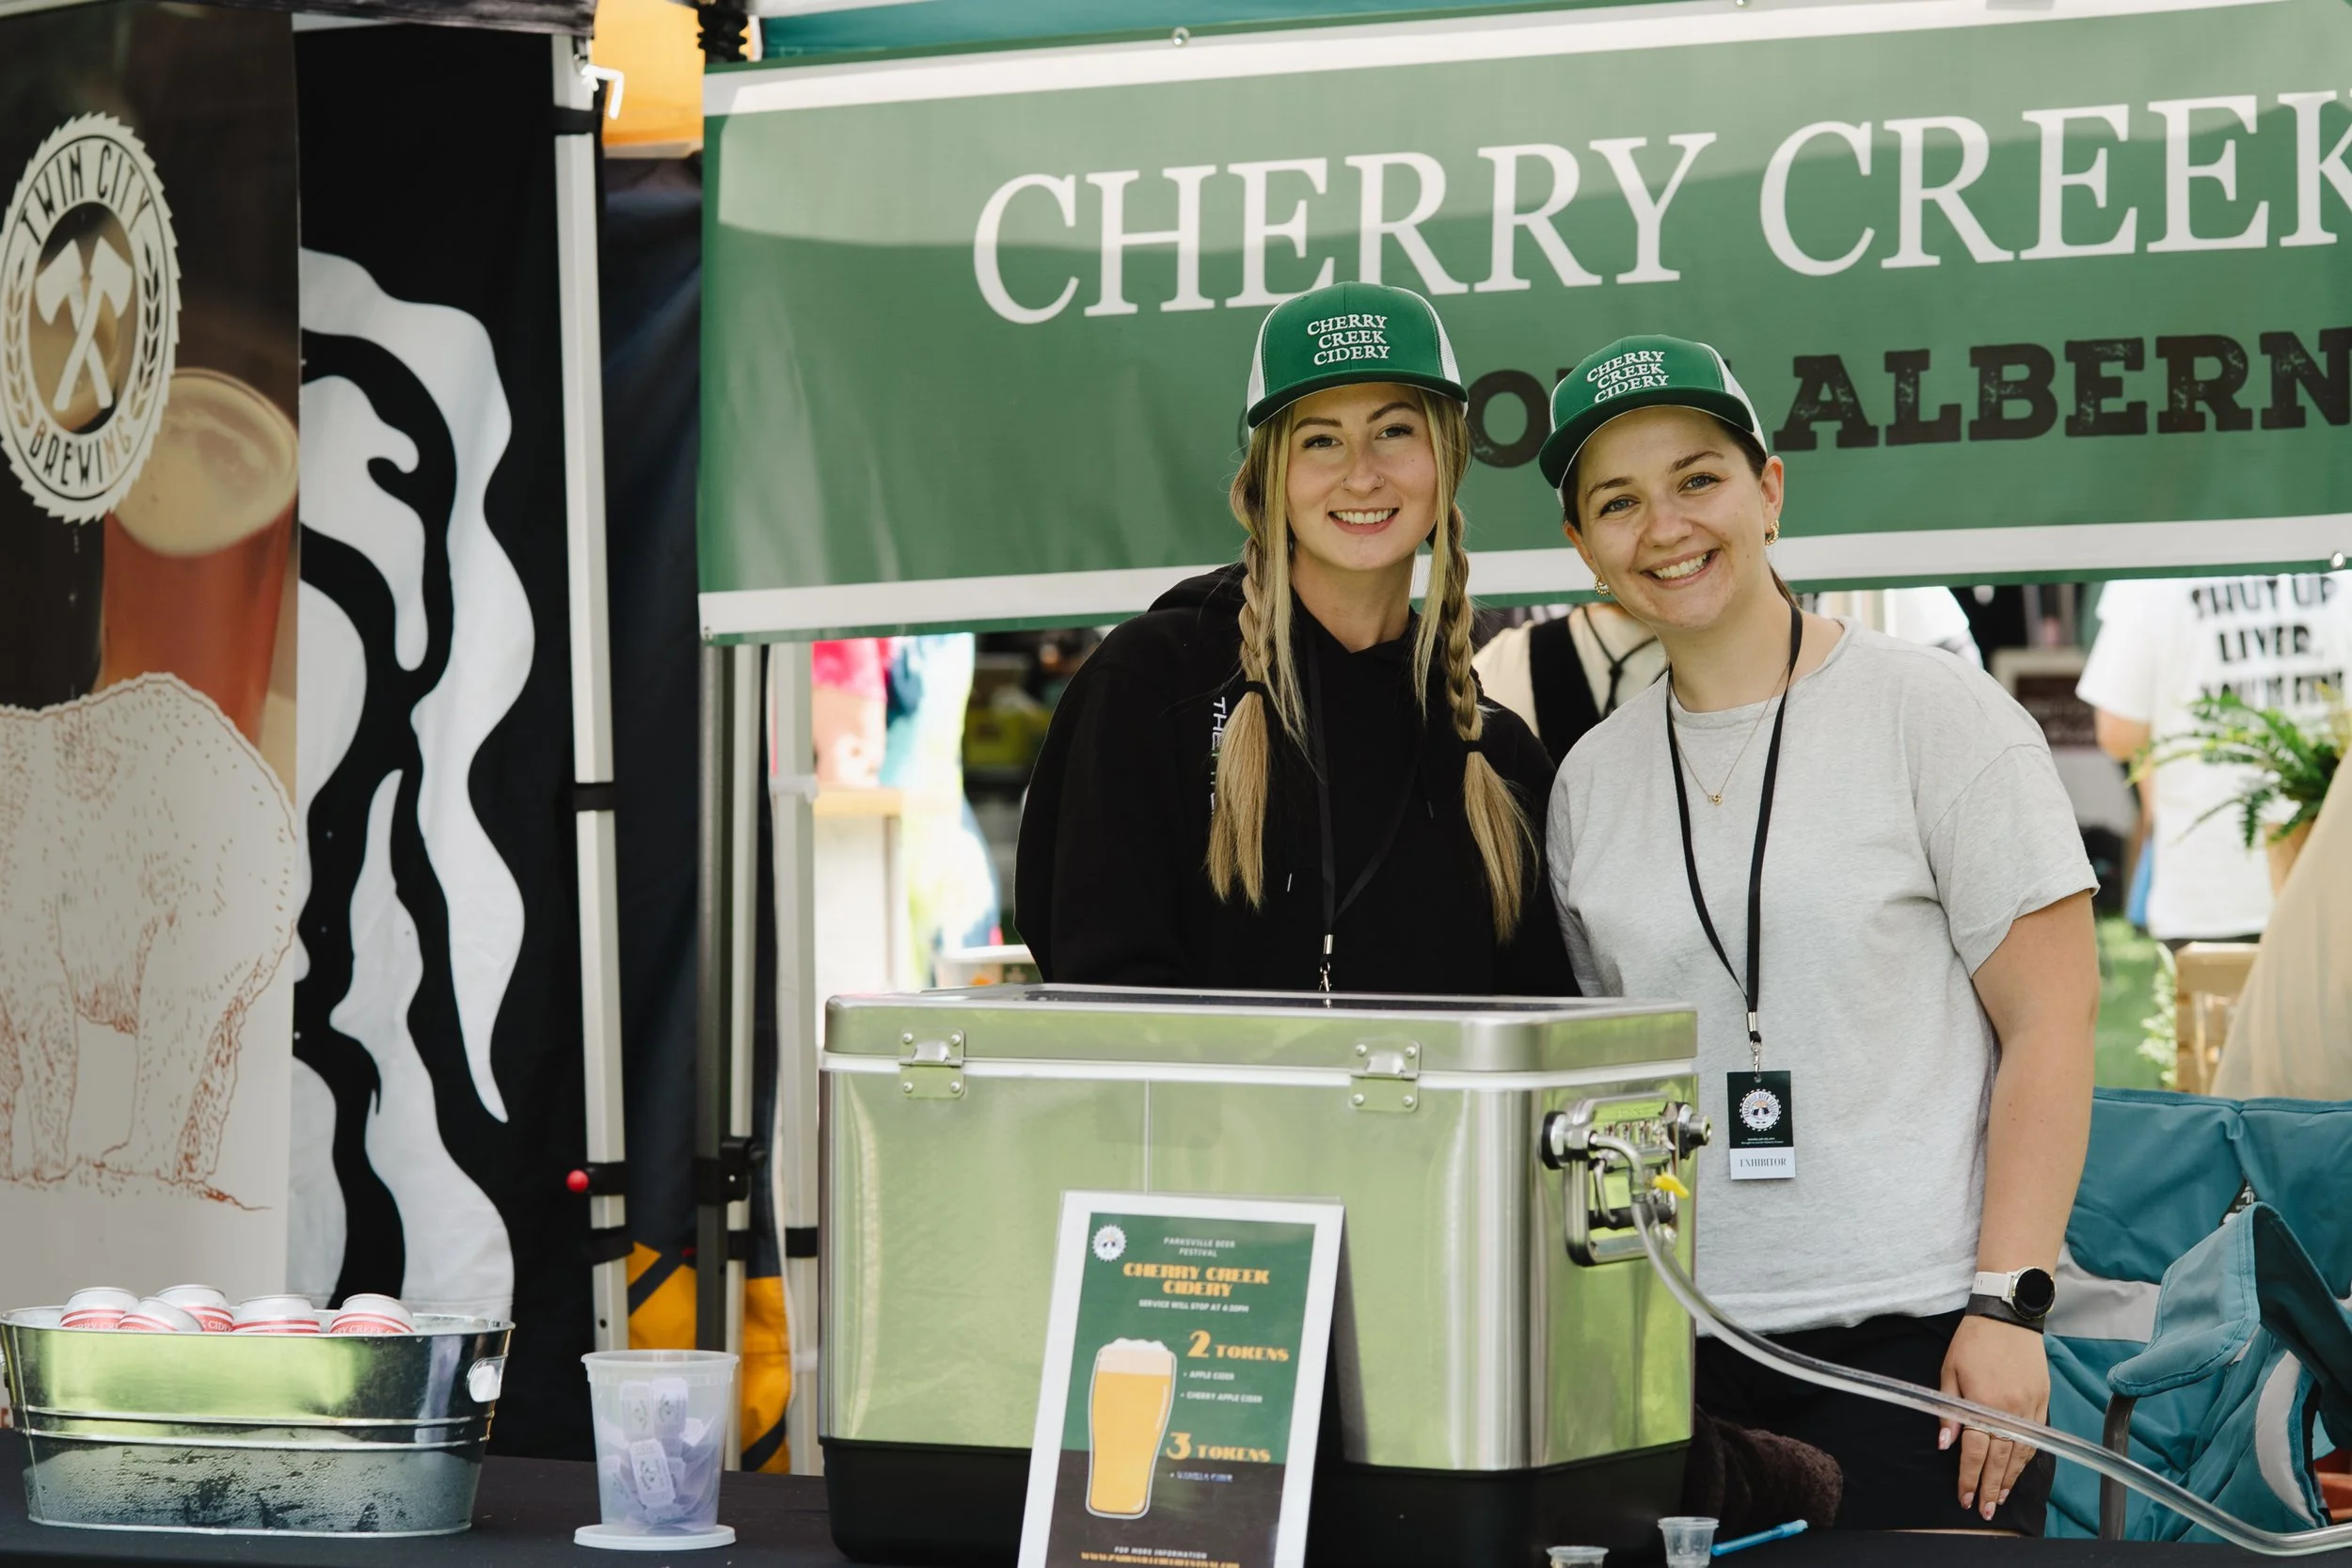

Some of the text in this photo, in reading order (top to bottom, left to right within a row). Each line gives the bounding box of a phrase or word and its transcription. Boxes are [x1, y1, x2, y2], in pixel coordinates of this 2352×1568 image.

[21, 144, 151, 245] TWIN CITY
[973, 88, 2352, 325] CHERRY CREEK
[1307, 314, 1388, 336] CHERRY
[1318, 330, 1387, 349] CREEK
[1313, 345, 1391, 366] CIDERY
[1586, 351, 1665, 383] CHERRY
[1594, 374, 1669, 404] CIDERY
[1597, 363, 1665, 389] CREEK
[1772, 327, 2352, 451] ALBERN
[29, 414, 133, 488] BREWING
[2192, 576, 2337, 618] SHUT UP
[1740, 1158, 1788, 1167] EXHIBITOR
[1163, 1237, 1236, 1249] PARKSVILLE BEER
[1179, 1247, 1217, 1258] FESTIVAL
[1123, 1262, 1270, 1285] CHERRY CREEK
[1163, 1279, 1233, 1298] CIDERY
[1187, 1329, 1290, 1362] 2 TOKENS
[1166, 1432, 1272, 1463] 3 TOKENS
